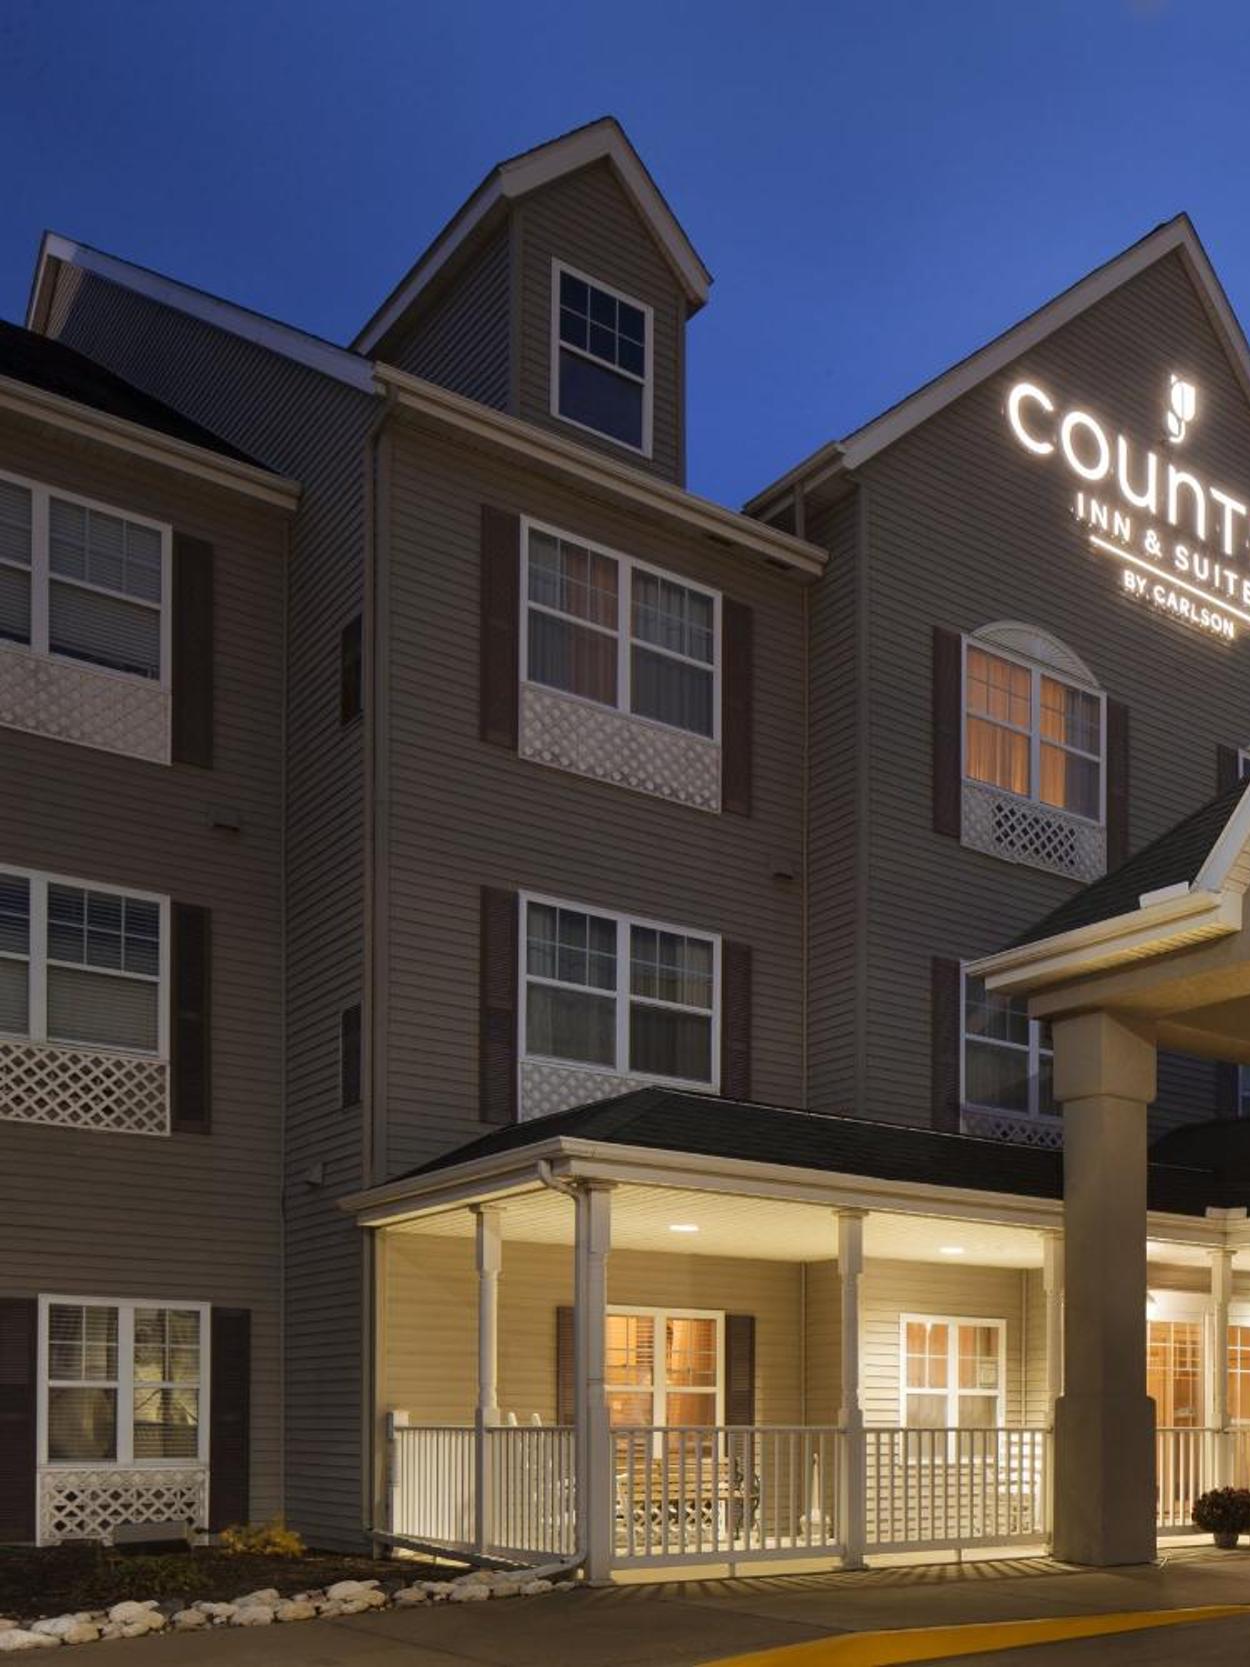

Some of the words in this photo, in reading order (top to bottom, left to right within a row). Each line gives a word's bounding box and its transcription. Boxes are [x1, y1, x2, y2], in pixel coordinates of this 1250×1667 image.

[1077, 492, 1131, 542] INN
[1143, 529, 1163, 558] &
[1123, 569, 1148, 595] BY
[1152, 584, 1235, 639] CARLSON
